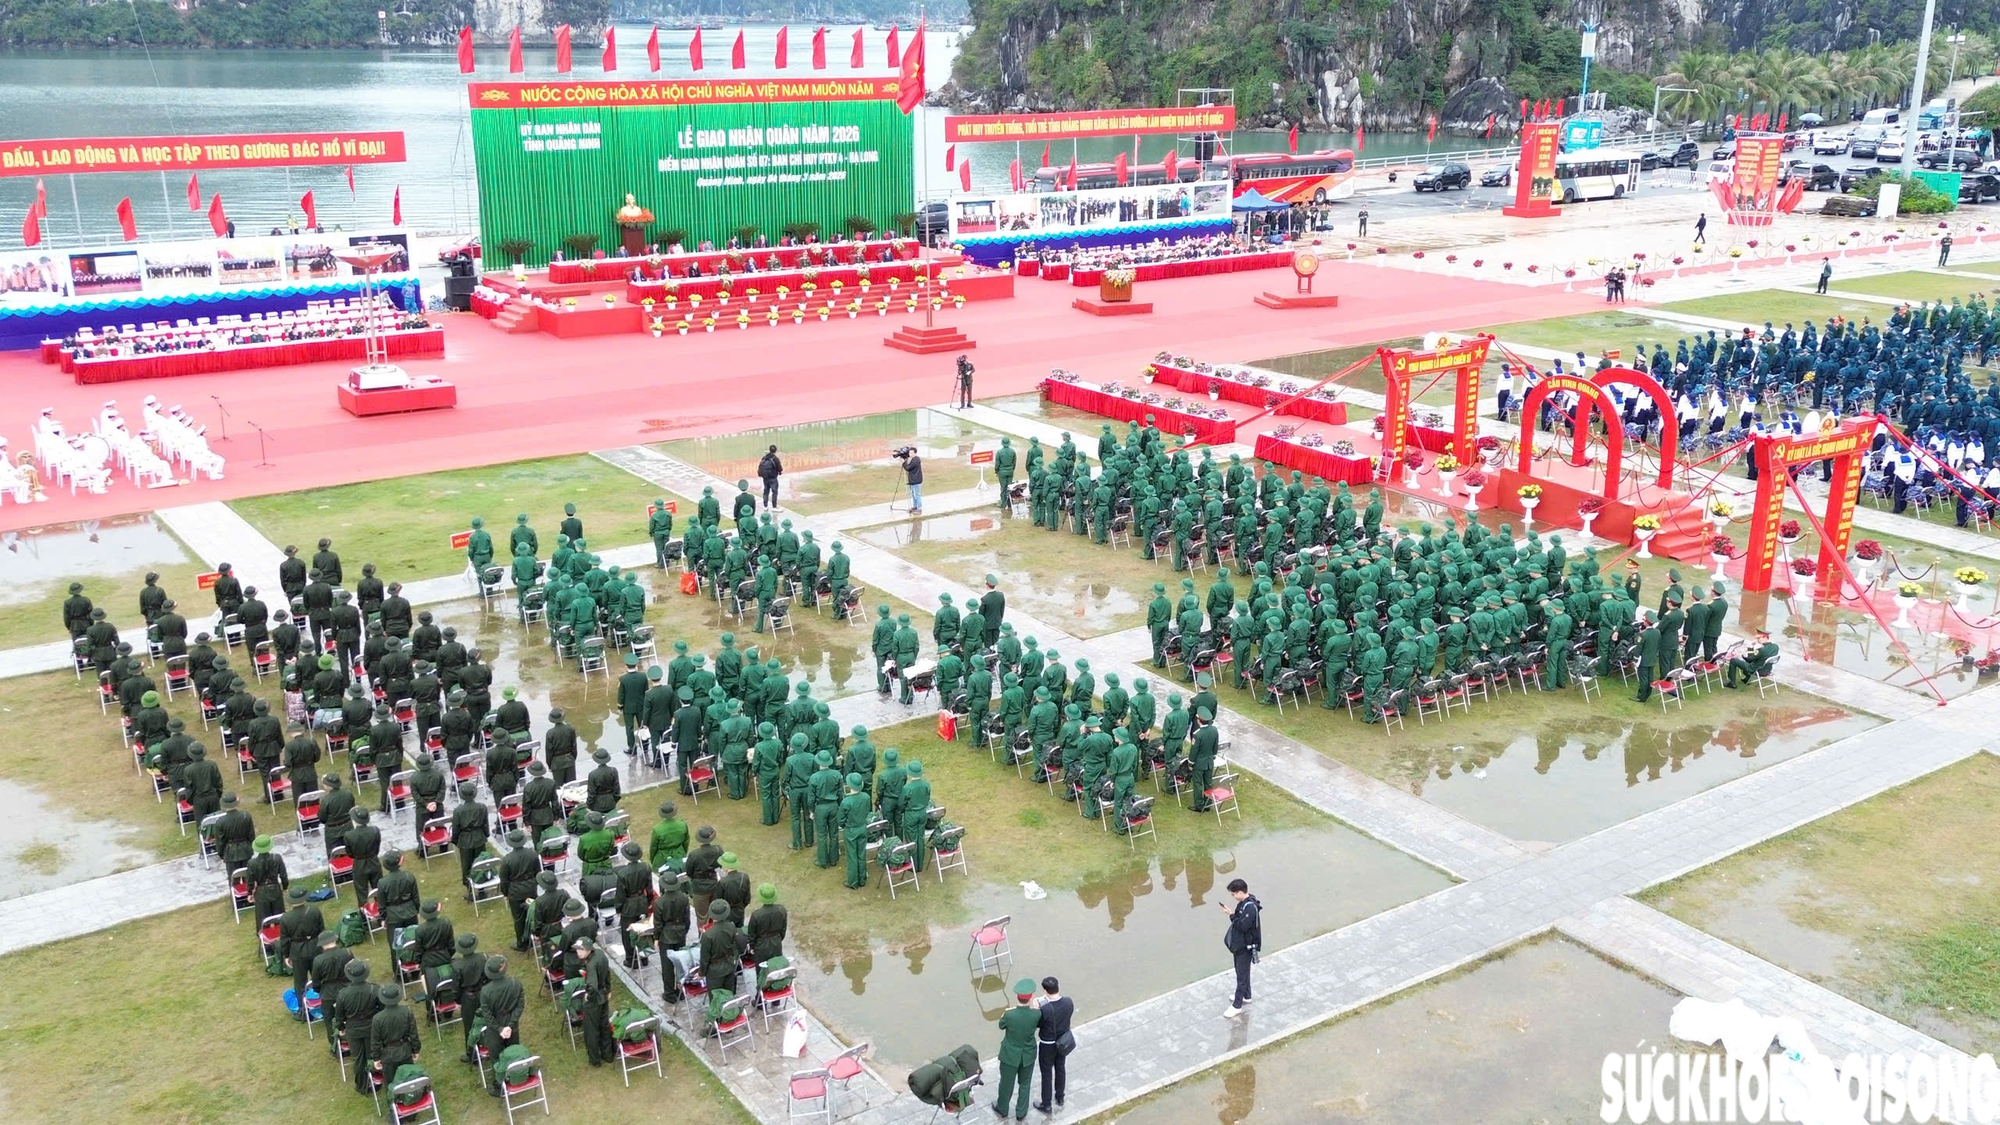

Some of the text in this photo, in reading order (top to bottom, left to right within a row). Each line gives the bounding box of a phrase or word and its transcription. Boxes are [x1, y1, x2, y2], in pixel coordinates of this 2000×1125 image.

[521, 81, 874, 104] NƯỚC CỘNG HÒA XÃ HỘI CHỦ NGHĨA VIỆT NAM MUÔN NĂM
[535, 124, 554, 135] BAN
[556, 121, 580, 134] NHÂN
[582, 121, 600, 134] DÂN
[678, 124, 860, 149] LỄ GIAO NHẬN QUÂN NĂM 2026
[3, 137, 385, 168] ĐẤU, LAO ĐỘNG VÀ HỌC TẬP THEO GƯƠNG BÁC HỒ VĨ ĐẠI!
[524, 136, 600, 151] TỈNH QUẢNG NINH
[1548, 378, 1599, 400] CẦU VINH QUANG
